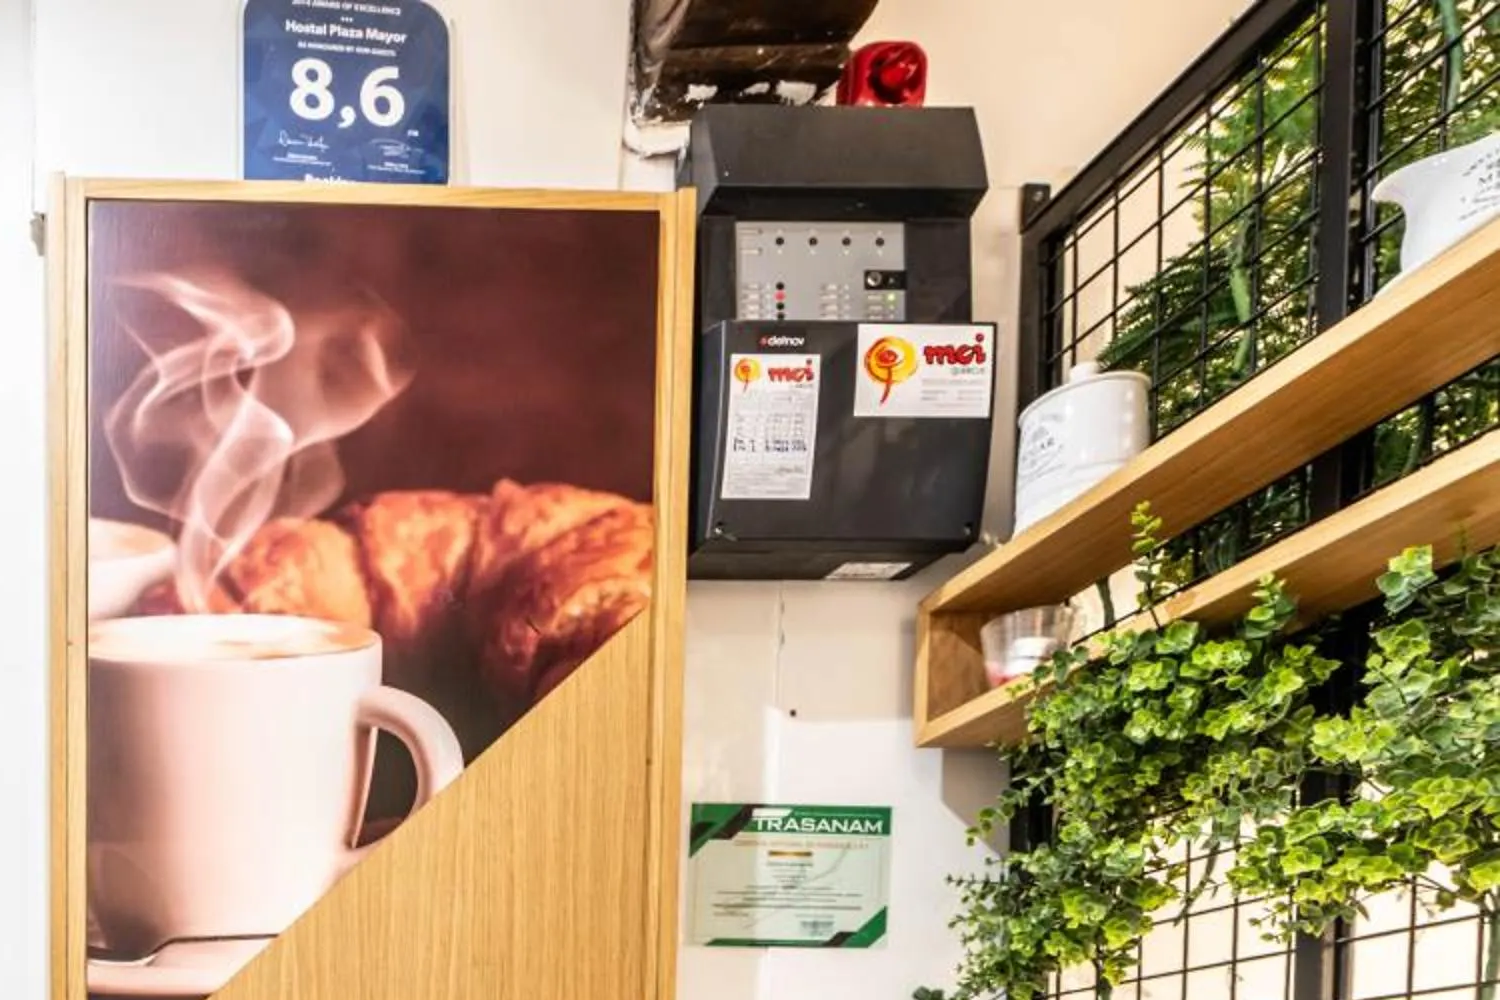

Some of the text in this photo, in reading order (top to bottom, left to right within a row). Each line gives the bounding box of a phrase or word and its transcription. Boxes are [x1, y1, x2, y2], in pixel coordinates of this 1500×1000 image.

[285, 19, 407, 44] Hostal Plaza Mayor
[289, 57, 405, 128] 8,6
[755, 817, 883, 834] TRASANAM
